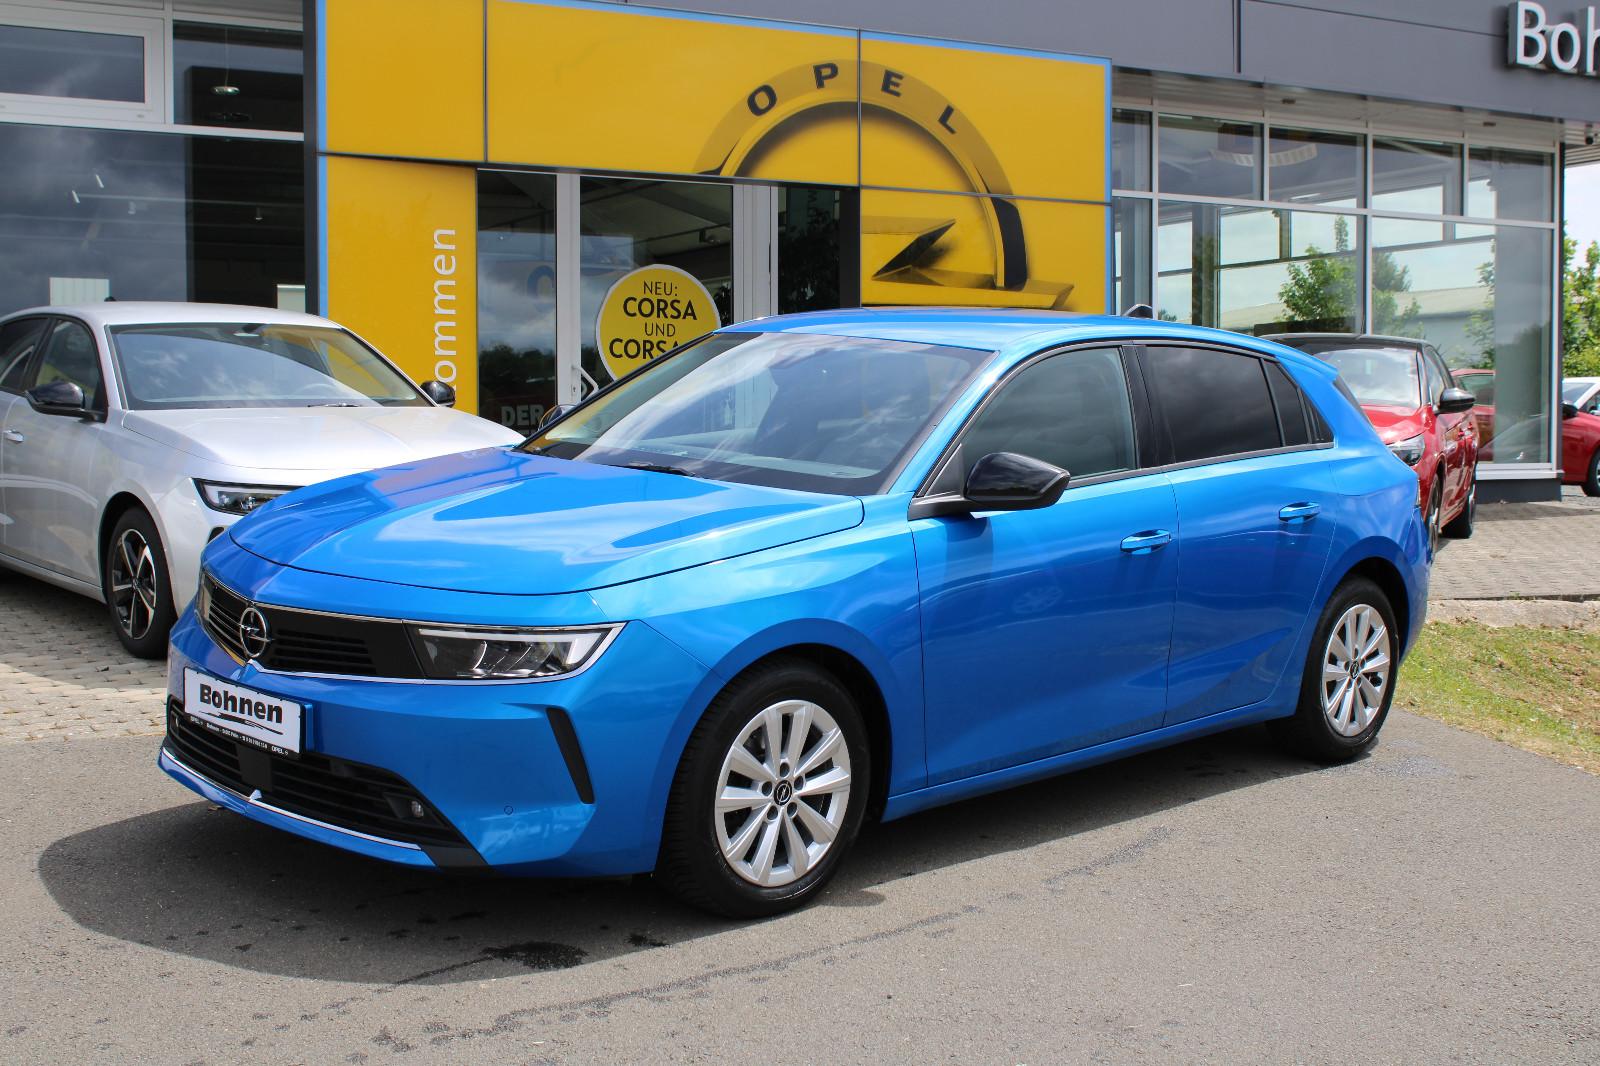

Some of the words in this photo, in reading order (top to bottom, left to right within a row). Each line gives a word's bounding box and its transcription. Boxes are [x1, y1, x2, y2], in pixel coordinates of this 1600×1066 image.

[746, 62, 957, 135] OPEL
[643, 280, 679, 297] NEU:
[433, 227, 458, 400] ommen
[622, 296, 698, 321] CORSA
[644, 322, 677, 338] UND
[199, 683, 284, 724] Bohnen
